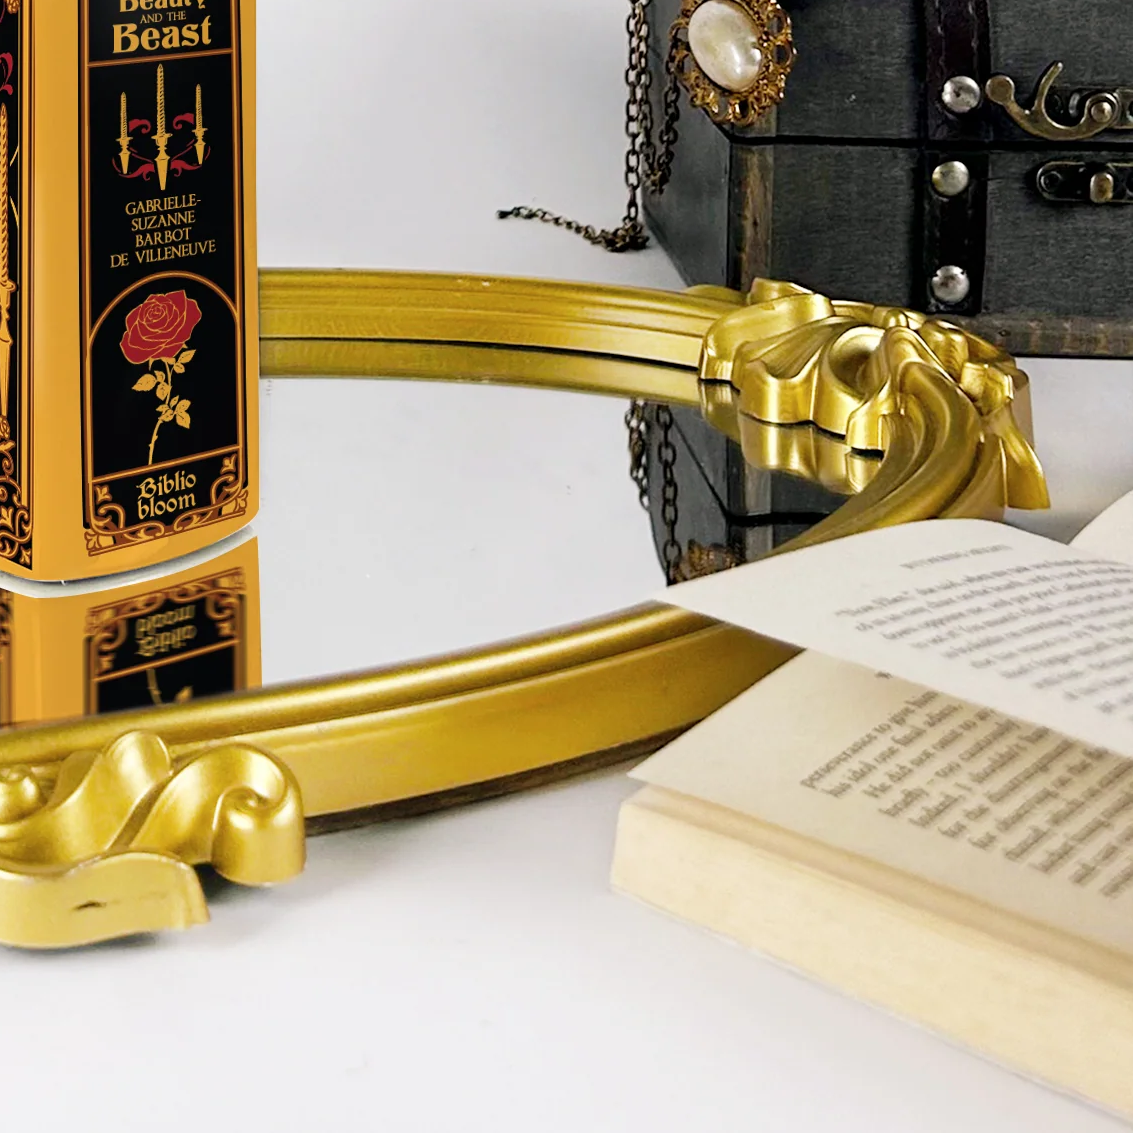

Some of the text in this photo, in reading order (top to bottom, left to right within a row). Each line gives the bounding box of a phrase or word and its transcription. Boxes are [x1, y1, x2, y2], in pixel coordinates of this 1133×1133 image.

[140, 10, 187, 24] AND THE
[112, 15, 212, 53] Beast
[125, 193, 202, 215] GABRIELLE-
[131, 210, 196, 231] SUZANNE
[135, 227, 192, 248] BARBOT
[110, 239, 217, 268] DE VILLENEUVE
[136, 470, 197, 500] Biblio
[137, 493, 197, 520] bloom
